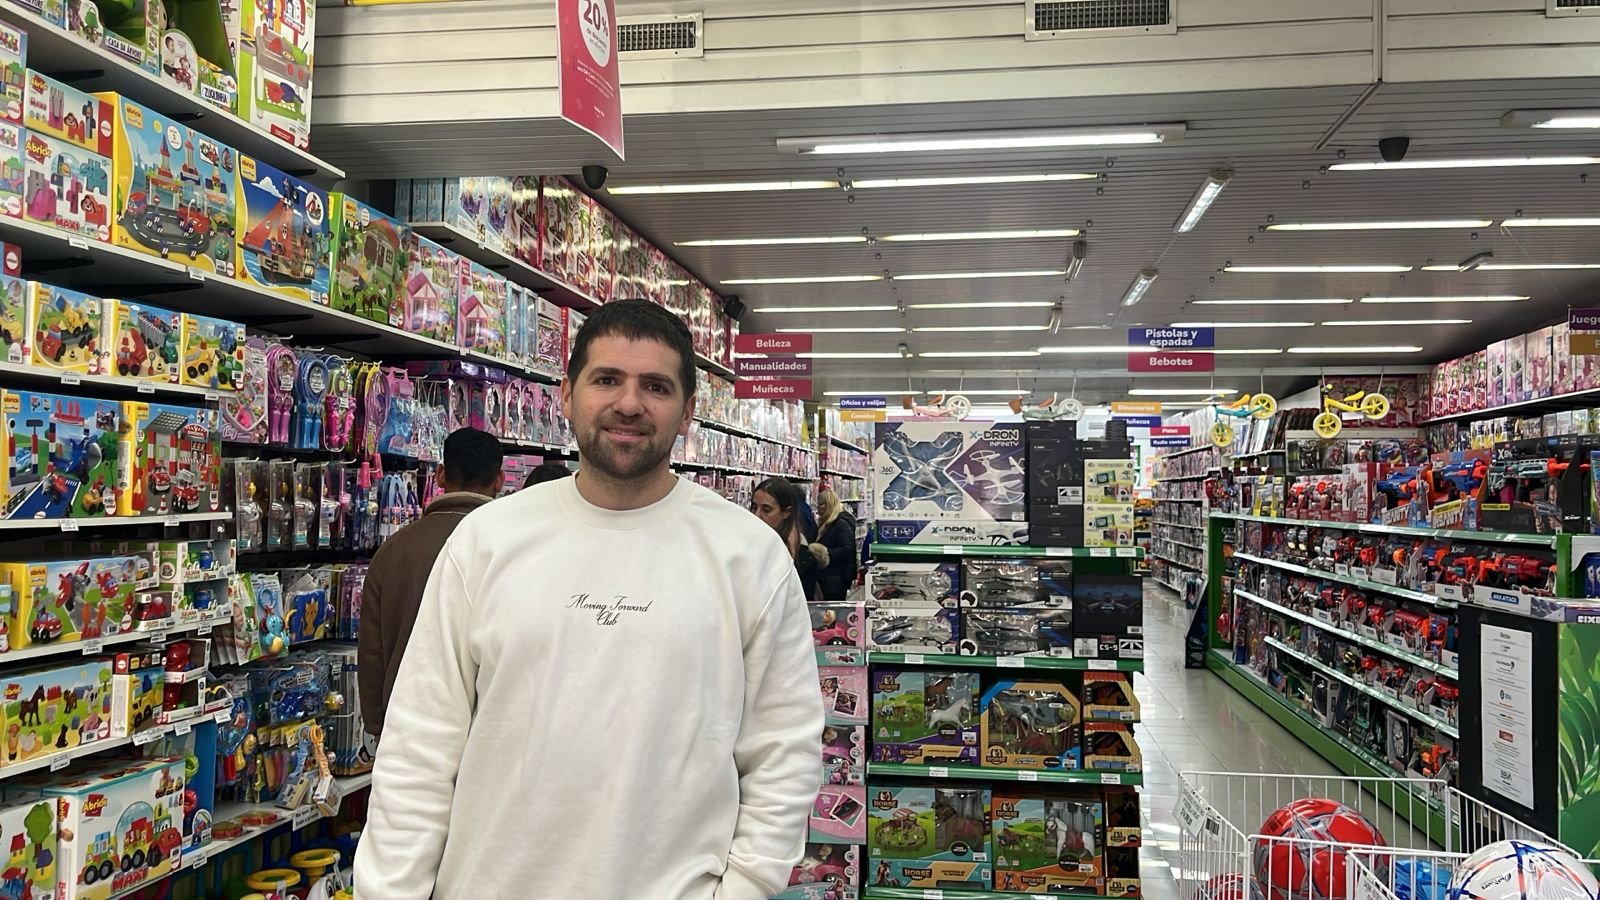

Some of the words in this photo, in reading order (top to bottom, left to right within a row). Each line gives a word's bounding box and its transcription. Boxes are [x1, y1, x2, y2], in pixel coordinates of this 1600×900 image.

[108, 38, 119, 48] CASA
[25, 140, 51, 158] Abrick
[1145, 329, 1188, 338] Pistolas
[1191, 331, 1198, 340] y
[756, 339, 792, 348] Belleza
[1149, 338, 1193, 348] espadas
[740, 361, 807, 372] Manualidades
[1149, 357, 1193, 366] Bebotes
[752, 383, 795, 394] Muñecas
[866, 399, 886, 407] valijas
[968, 430, 1019, 440] X-DRON
[1153, 438, 1168, 446] Radio
[1168, 438, 1188, 446] control
[565, 593, 608, 617] Moving
[610, 595, 653, 612] Forward
[596, 610, 620, 625] Club
[81, 797, 108, 814] Abrick
[873, 800, 897, 808] HORSE
[904, 869, 931, 878] HORSE
[111, 868, 148, 894] MAXI
